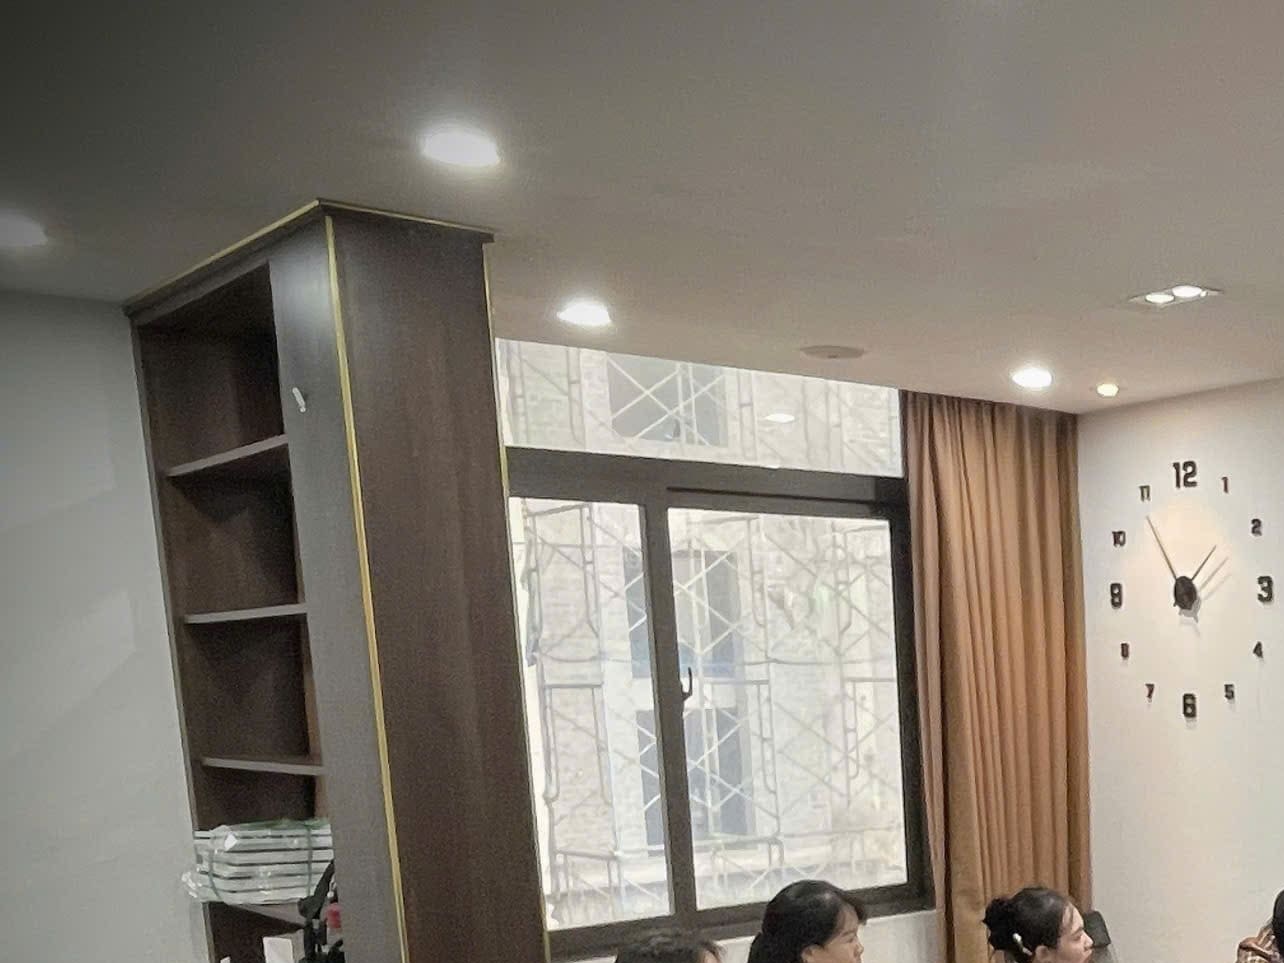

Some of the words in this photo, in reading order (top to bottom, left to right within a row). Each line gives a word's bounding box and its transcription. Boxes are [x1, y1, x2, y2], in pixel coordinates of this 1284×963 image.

[1173, 461, 1197, 488] 12
[1221, 476, 1229, 493] 1
[1251, 518, 1263, 536] 2
[1112, 531, 1126, 547] 10
[1257, 576, 1273, 602] 3
[1253, 641, 1263, 658] 4
[1145, 684, 1155, 701] 7
[1224, 684, 1235, 700] 5
